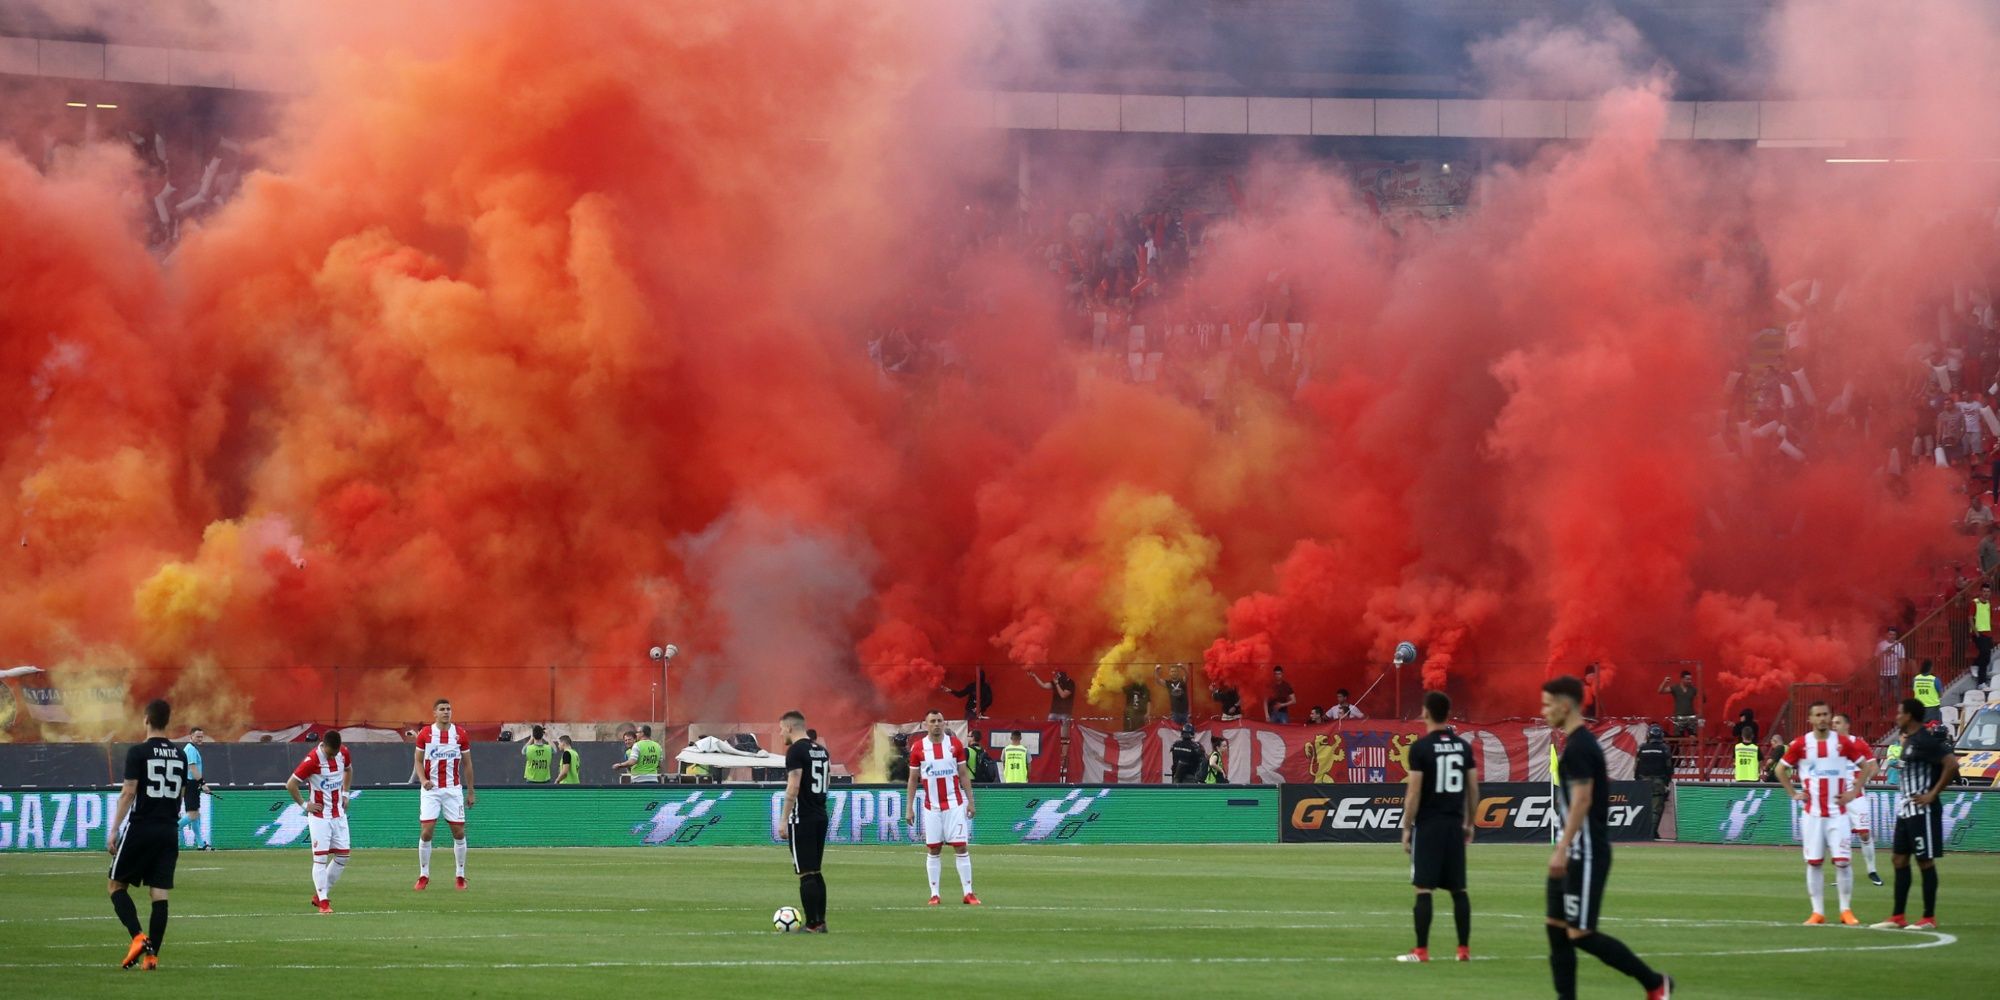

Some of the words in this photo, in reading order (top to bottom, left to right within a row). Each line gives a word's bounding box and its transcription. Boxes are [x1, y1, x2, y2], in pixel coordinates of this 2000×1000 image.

[146, 759, 184, 799] 55
[811, 760, 829, 794] 51
[1435, 753, 1464, 793] 16
[1292, 797, 1406, 829] G-ENE
[1374, 797, 1405, 805] ENGI
[1475, 796, 1644, 829] G-ENGY
[0, 793, 212, 850] GAZP
[957, 823, 964, 836] 7
[1914, 836, 1925, 850] 3
